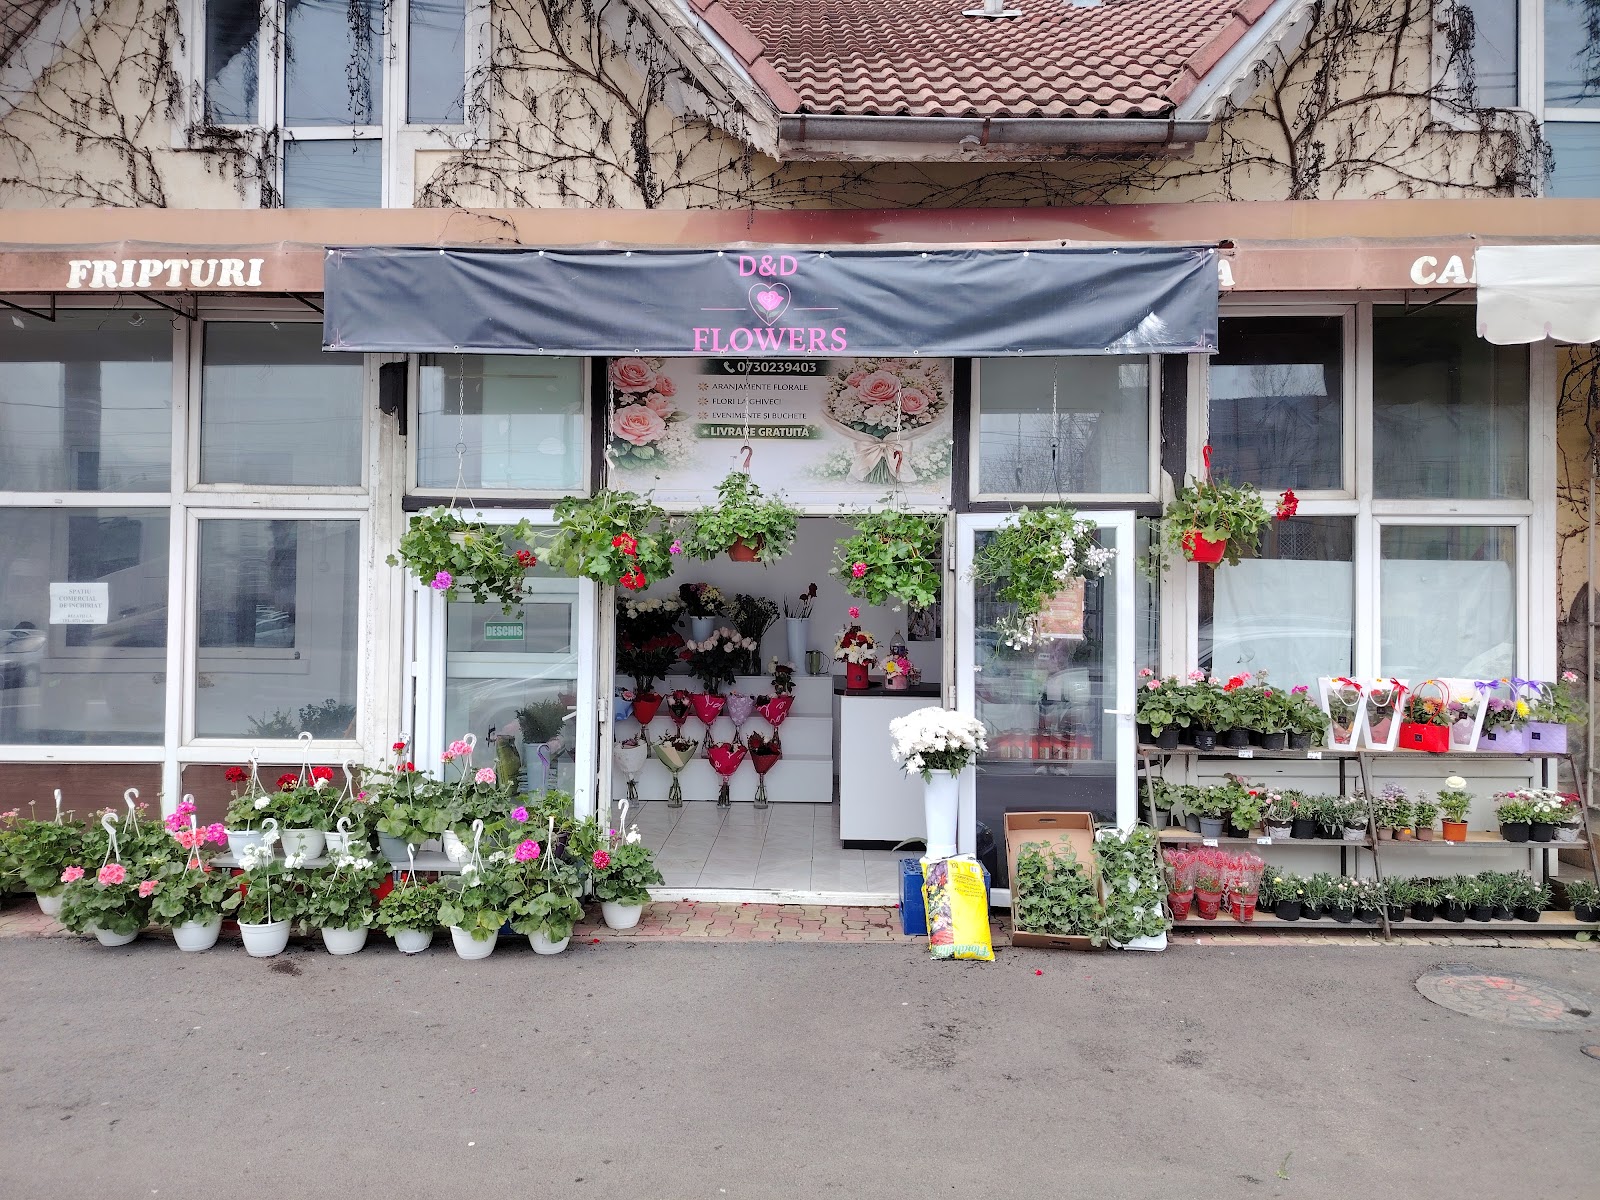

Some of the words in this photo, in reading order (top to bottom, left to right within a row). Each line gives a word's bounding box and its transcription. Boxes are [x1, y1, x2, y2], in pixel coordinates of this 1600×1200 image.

[739, 255, 798, 277] D&D
[1410, 255, 1477, 285] CA
[66, 258, 264, 288] FRIPTURI
[692, 327, 848, 352] FLOWERS
[737, 361, 817, 373] 0730239403
[712, 383, 771, 391] ARANJAMENTE
[773, 383, 809, 391] FLORALE
[772, 412, 807, 420] BUCHETE
[710, 426, 756, 437] LIVRARE
[486, 625, 523, 637] DESCHIS
